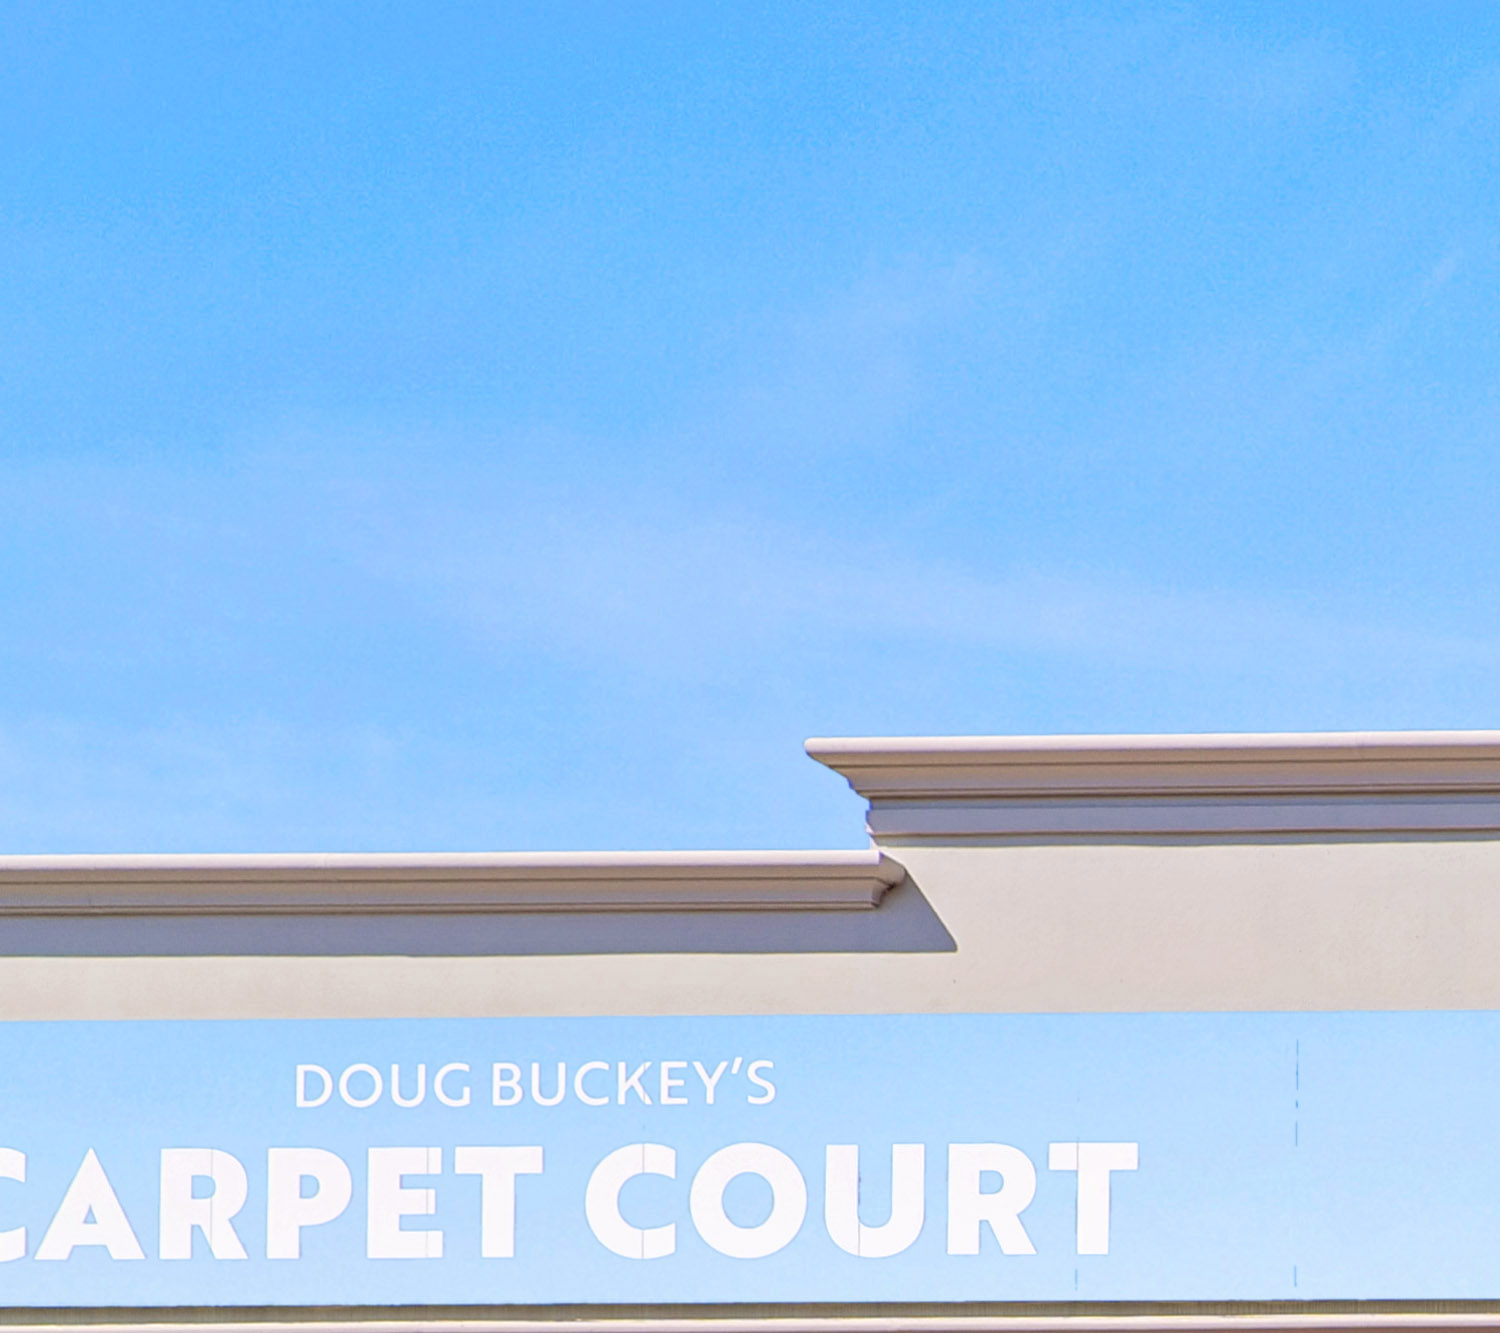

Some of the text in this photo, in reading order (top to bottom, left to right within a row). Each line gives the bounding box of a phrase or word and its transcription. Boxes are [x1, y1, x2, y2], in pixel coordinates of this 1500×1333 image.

[295, 1057, 777, 1108] DOUG BUCKEY'S
[0, 1141, 1140, 1263] ARPET COURT
